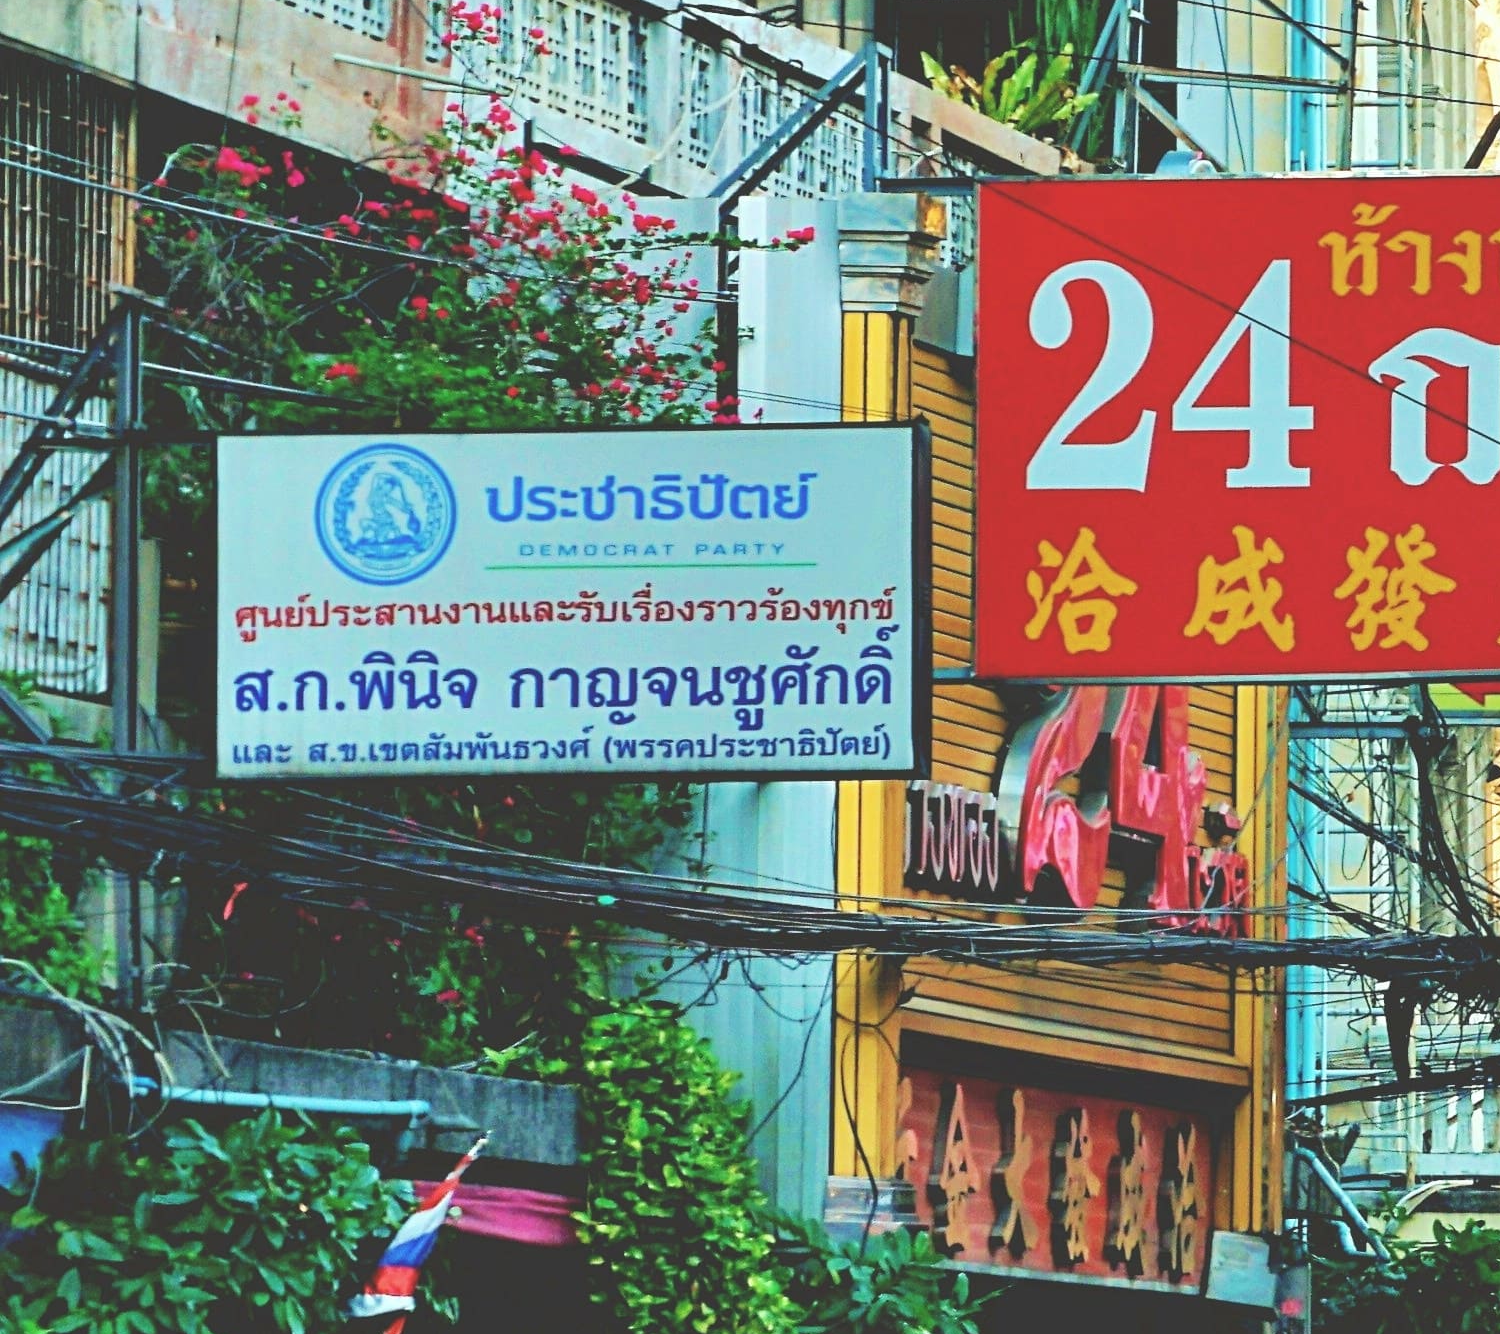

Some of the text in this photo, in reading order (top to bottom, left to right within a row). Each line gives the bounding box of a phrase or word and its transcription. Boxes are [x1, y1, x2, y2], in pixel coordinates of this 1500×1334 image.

[1024, 257, 1316, 495] 24
[485, 470, 819, 527] ประชาธิปัตย์
[519, 542, 786, 558] DEMOCRAT PARTY
[233, 579, 898, 647] ศูนย์ประสานงานและรับเรื่องราวร้องทุกข์
[231, 624, 901, 732] ส.ก.พินิจ กาญจนชูศักดิ์
[232, 737, 294, 766] และ
[601, 723, 893, 766] (พรรคประชาธิปัตย์)
